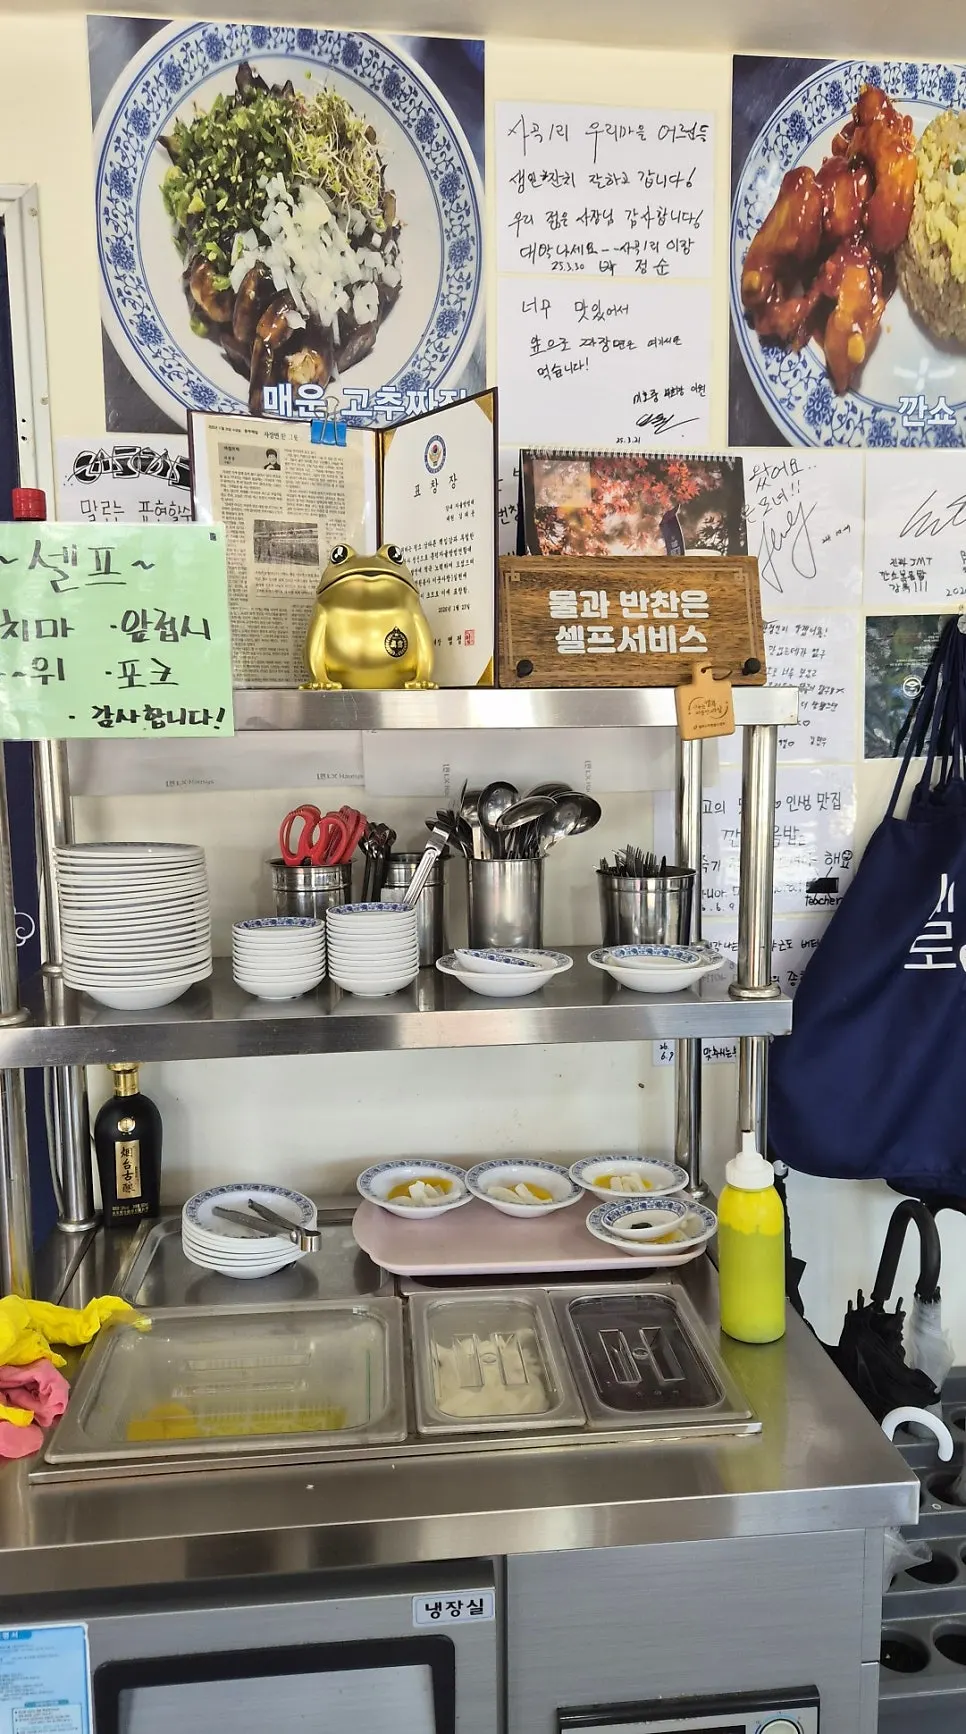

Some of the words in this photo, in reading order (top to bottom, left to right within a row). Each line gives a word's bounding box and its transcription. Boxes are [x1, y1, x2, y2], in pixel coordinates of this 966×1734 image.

[589, 172, 630, 189] 잘하고
[638, 167, 696, 188] 갑니다!
[508, 211, 534, 238] 우리
[545, 210, 569, 230] 젊은
[576, 207, 614, 227] 사장님
[625, 205, 704, 230] 감사합니다!
[522, 297, 552, 319] 너무
[574, 299, 629, 323] 맛있어서
[530, 334, 571, 355] 앞으로
[579, 336, 638, 353] 짜장면은
[537, 357, 589, 380] 먹습니다!
[262, 383, 326, 418] 매운
[898, 395, 957, 427] 깐쇼
[910, 556, 933, 567] JMT
[549, 590, 610, 619] 물과
[619, 590, 710, 619] 반찬은
[555, 625, 709, 655] 셀프서비스
[91, 703, 227, 730] 감사합니다!
[786, 794, 812, 812] 인생
[817, 791, 842, 811] 맛집
[425, 1598, 484, 1620] 냉장실
